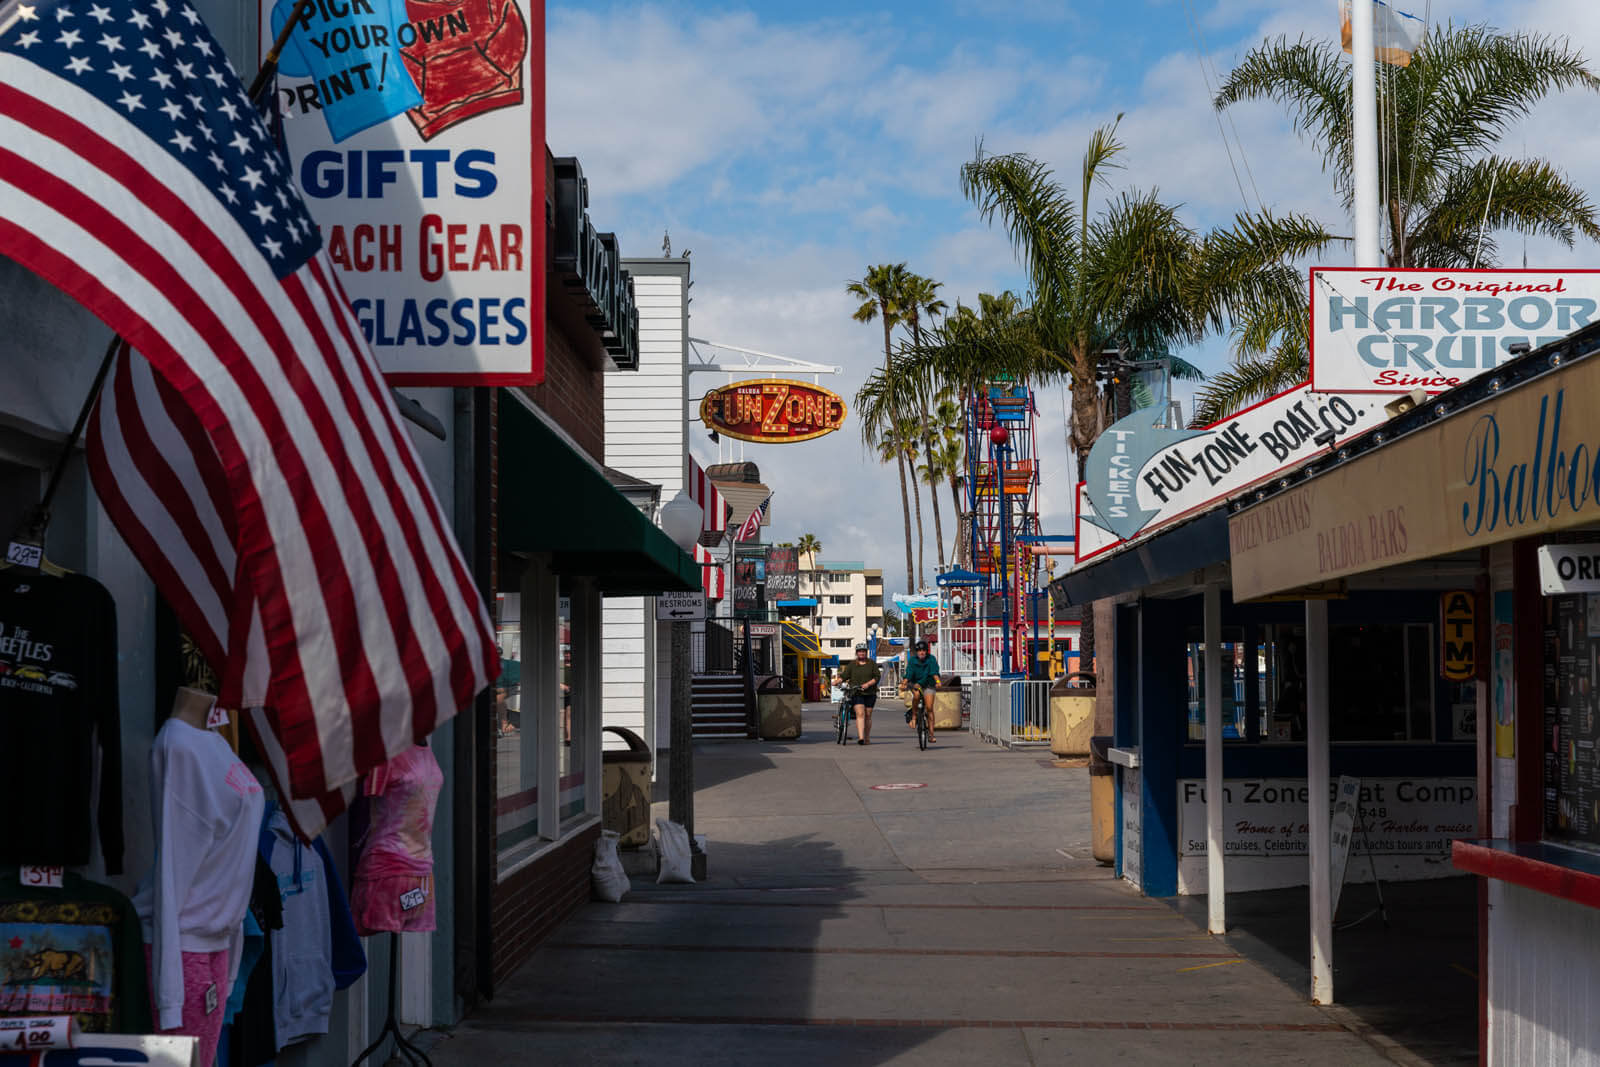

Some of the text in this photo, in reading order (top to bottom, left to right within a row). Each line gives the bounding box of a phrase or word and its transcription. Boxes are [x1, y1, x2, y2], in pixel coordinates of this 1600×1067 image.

[309, 9, 469, 58] YOUR OWN
[301, 149, 498, 199] GIFTS
[328, 213, 523, 282] ACH GEAR
[1360, 276, 1567, 297] The Original
[351, 297, 527, 346] GLASSES
[1328, 295, 1597, 335] HARBOR
[1373, 370, 1463, 387] Since
[704, 384, 842, 433] FUN ZONE
[1143, 396, 1366, 503] FUN ZONE BOAT CO.
[1106, 430, 1137, 519] TICKETS
[1317, 505, 1408, 574] BALBOA BARS
[667, 591, 694, 599] PUBLIC
[734, 586, 757, 600] TDOGS
[767, 575, 797, 589] BURGERS
[659, 599, 703, 608] RESTROOMS
[1446, 594, 1472, 663] ATM
[0, 636, 54, 664] EETLES
[1244, 783, 1309, 804] Zone
[1396, 781, 1478, 804] Comp
[1236, 820, 1275, 834] Home
[1280, 821, 1294, 837] of
[1381, 819, 1429, 833] Harbor
[1264, 839, 1307, 853] Celebrity
[1397, 839, 1420, 851] tours
[1424, 839, 1443, 851] and
